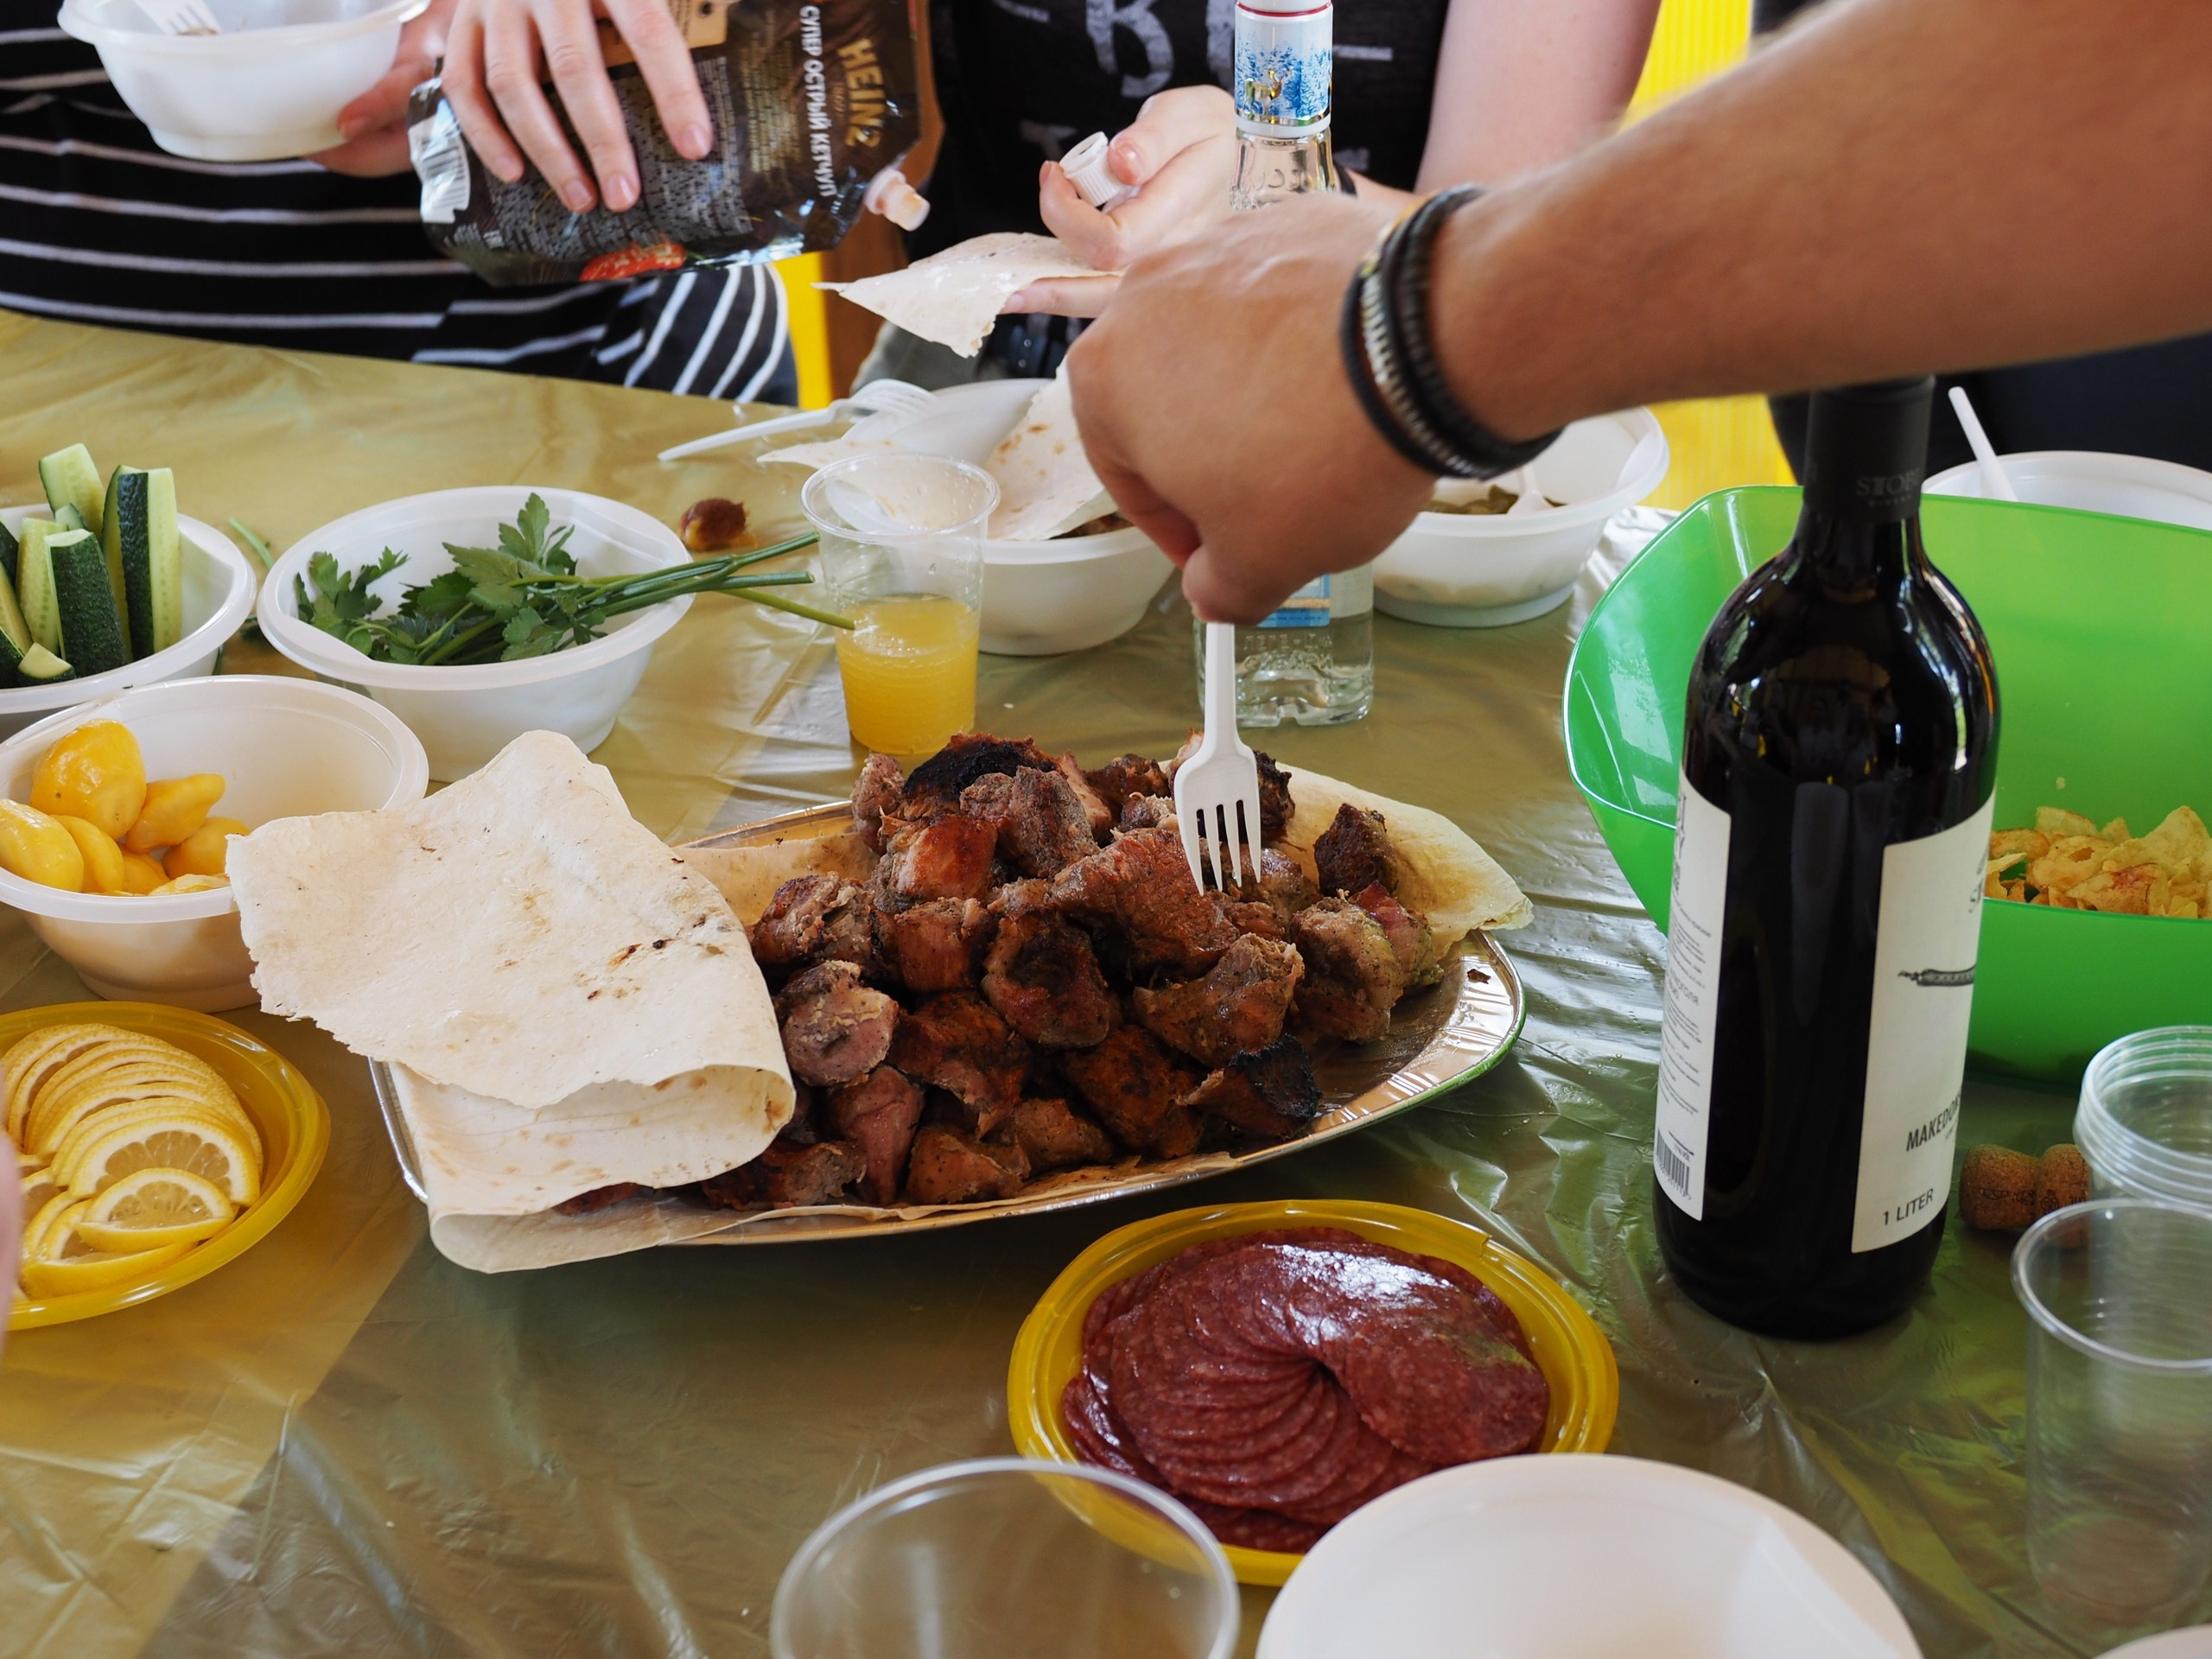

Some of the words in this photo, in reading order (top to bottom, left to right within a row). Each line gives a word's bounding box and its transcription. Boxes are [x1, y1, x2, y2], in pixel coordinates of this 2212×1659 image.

[799, 5, 823, 56] СУПЕР
[803, 59, 832, 130] ОСТРЫЙ
[837, 38, 885, 148] HEINZ
[810, 133, 837, 197] КЕТЧУП
[1883, 1211, 1889, 1225] 1
[1897, 1188, 1934, 1221] LITER
